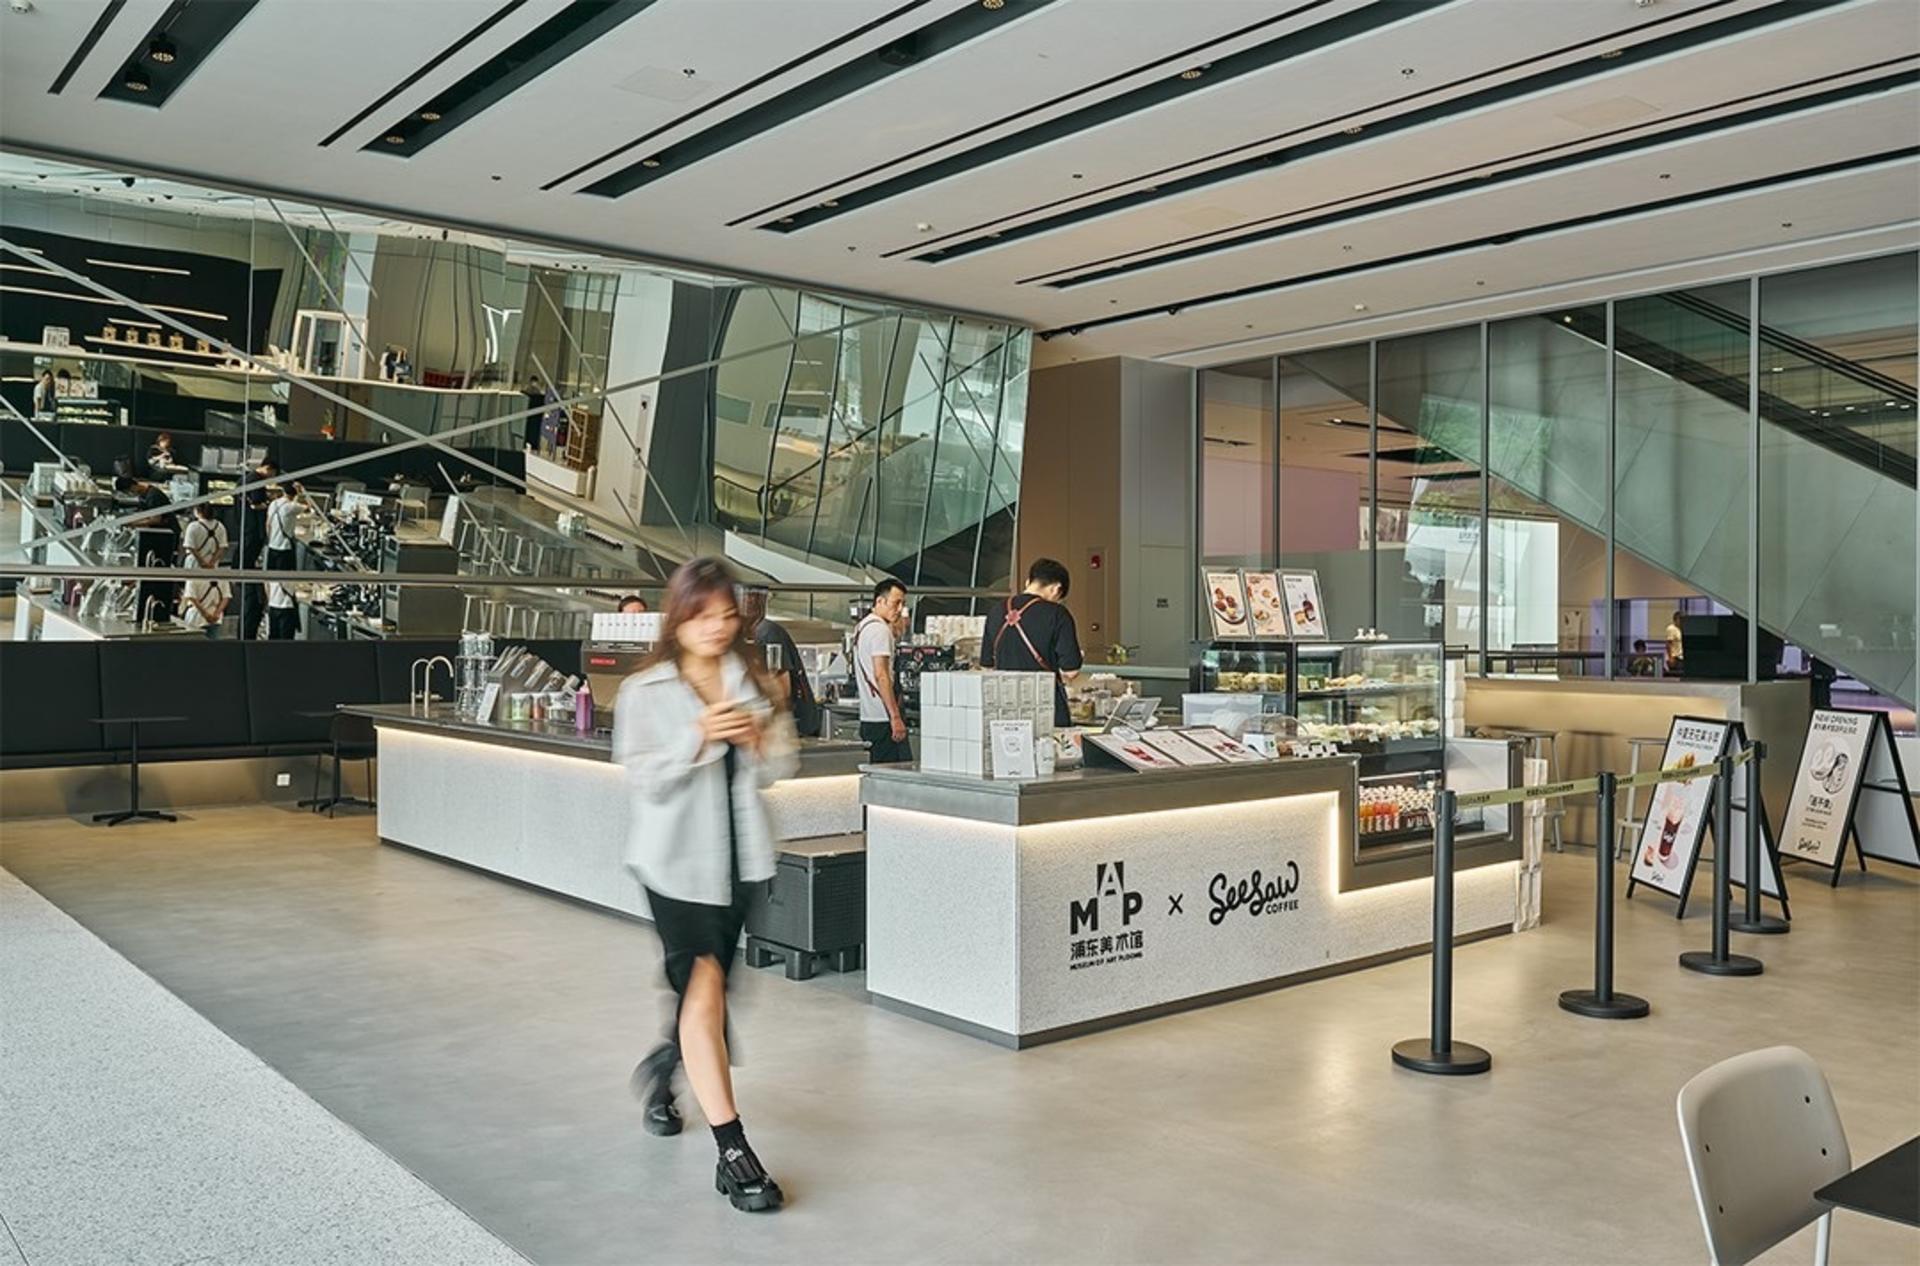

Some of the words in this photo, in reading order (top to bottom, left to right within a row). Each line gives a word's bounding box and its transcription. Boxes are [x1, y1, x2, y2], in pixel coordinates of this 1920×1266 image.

[1070, 861, 1143, 935] MAP
[1265, 899, 1299, 915] COFFEE
[1070, 930, 1144, 961] 浦东美术馆
